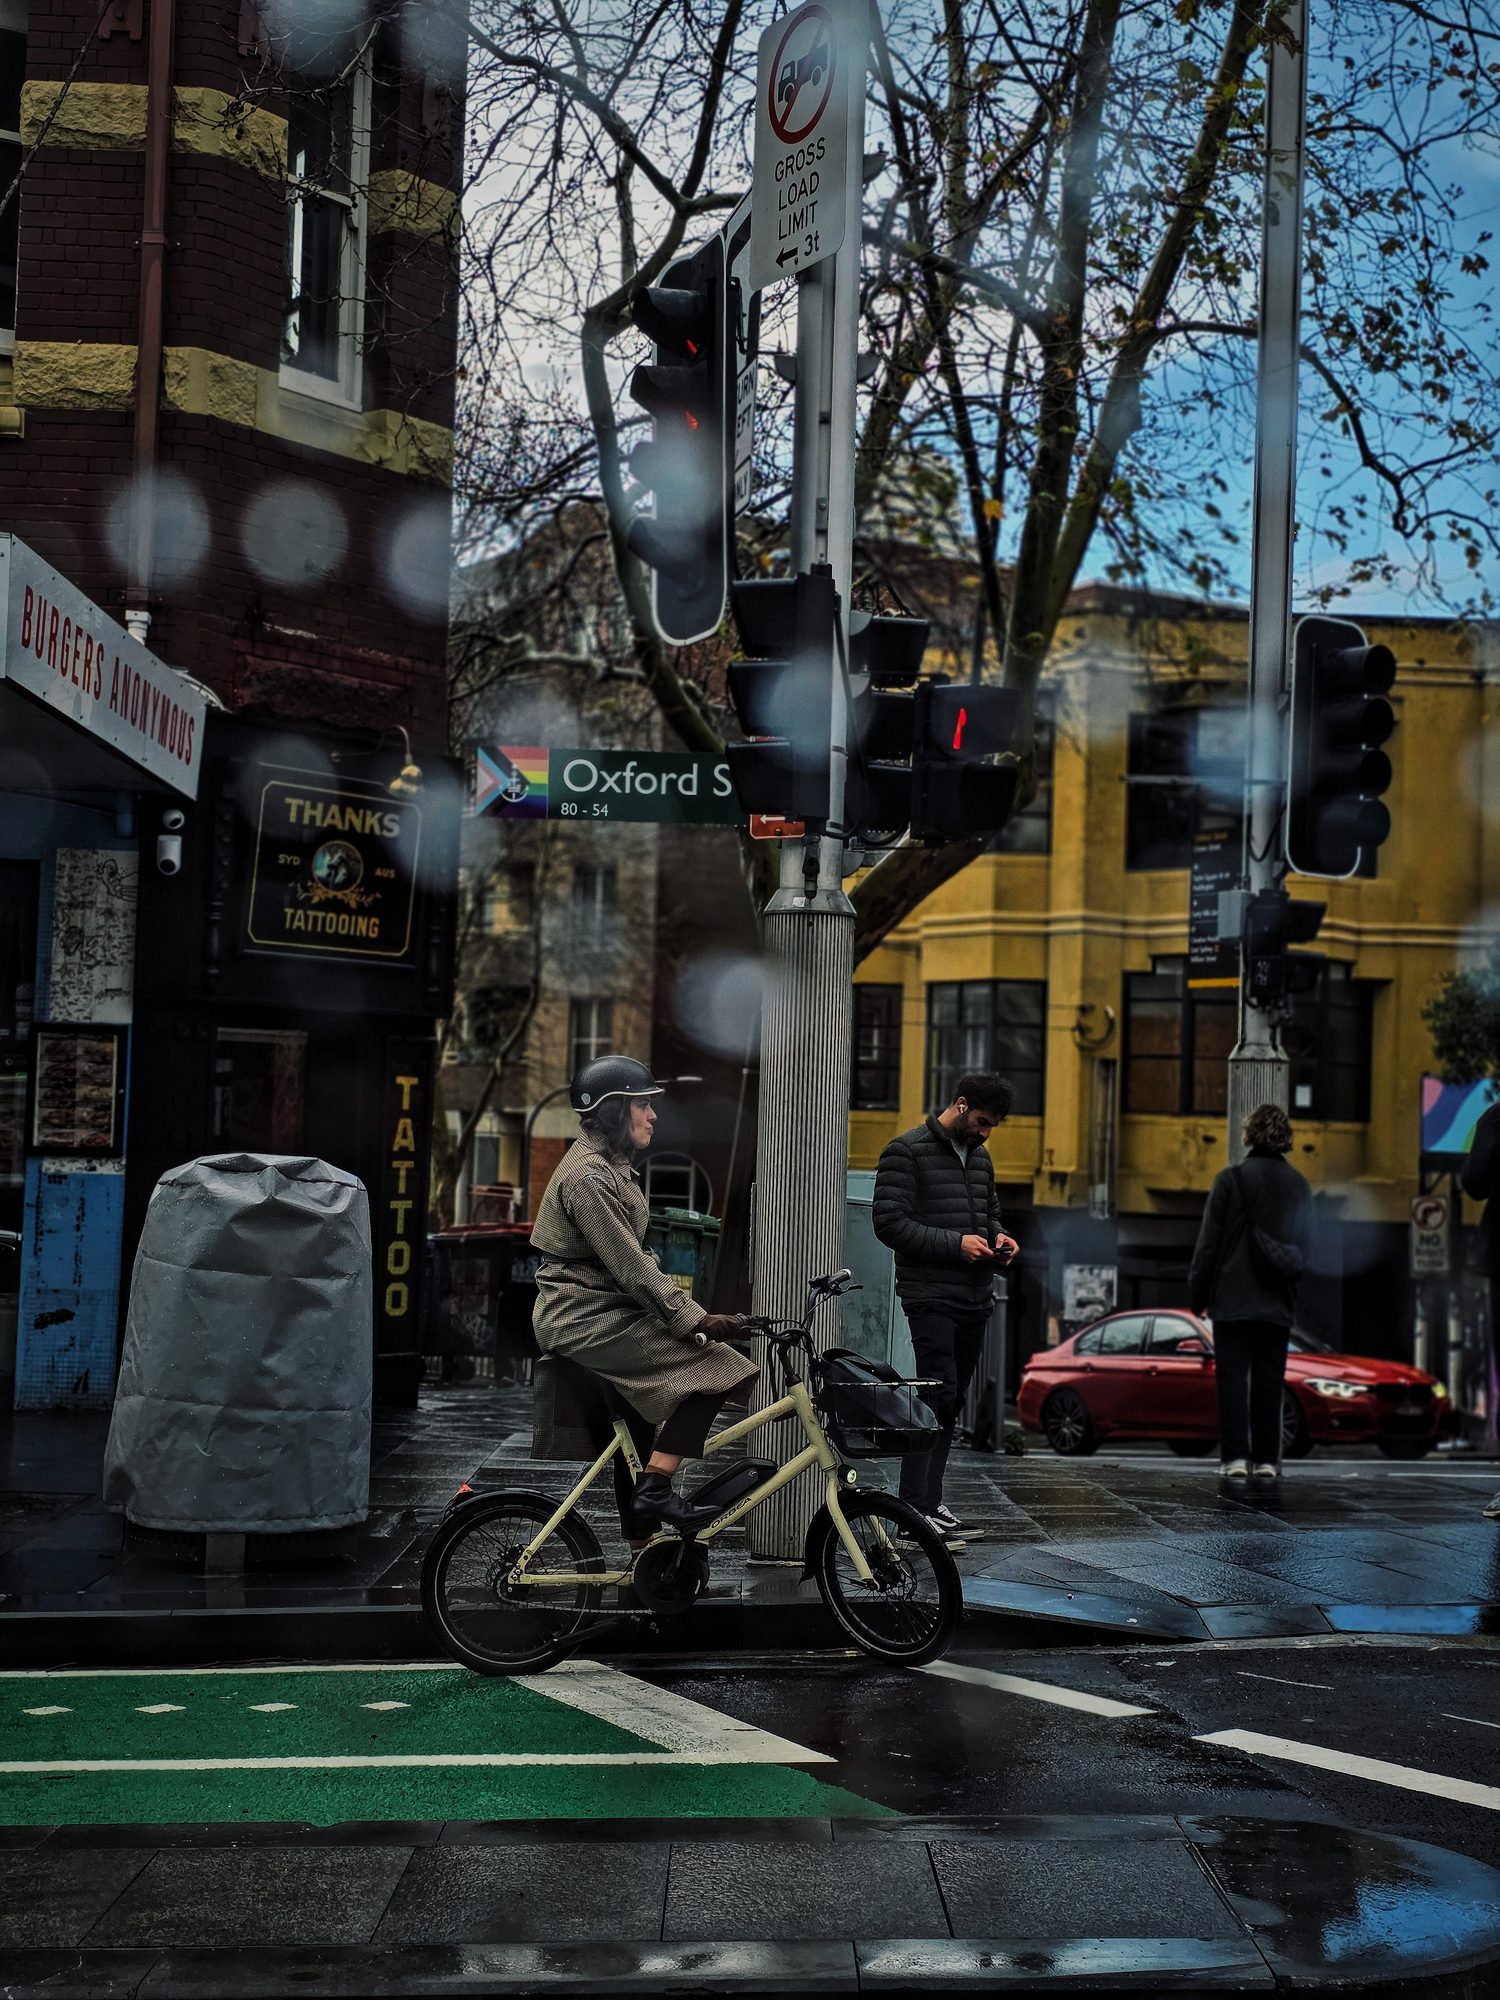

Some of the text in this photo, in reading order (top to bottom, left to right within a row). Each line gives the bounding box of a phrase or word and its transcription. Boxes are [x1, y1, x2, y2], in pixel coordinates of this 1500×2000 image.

[775, 137, 826, 183] GROSS
[778, 171, 820, 212] LOAD
[778, 200, 818, 241] LIMIT
[803, 230, 820, 257] 3t
[737, 369, 754, 404] URN
[737, 404, 752, 438] EFT
[21, 584, 194, 766] BURGERS ANONYMOUS
[563, 759, 732, 796] Oxford S
[284, 797, 401, 839] THANKS
[561, 803, 578, 816] 80
[592, 804, 609, 817] 54
[278, 854, 396, 879] SYD AUS
[284, 907, 381, 939] TATTOOING
[385, 1076, 419, 1316] TATTOO
[1419, 1233, 1440, 1246] NO
[711, 1497, 752, 1529] ORBEA
